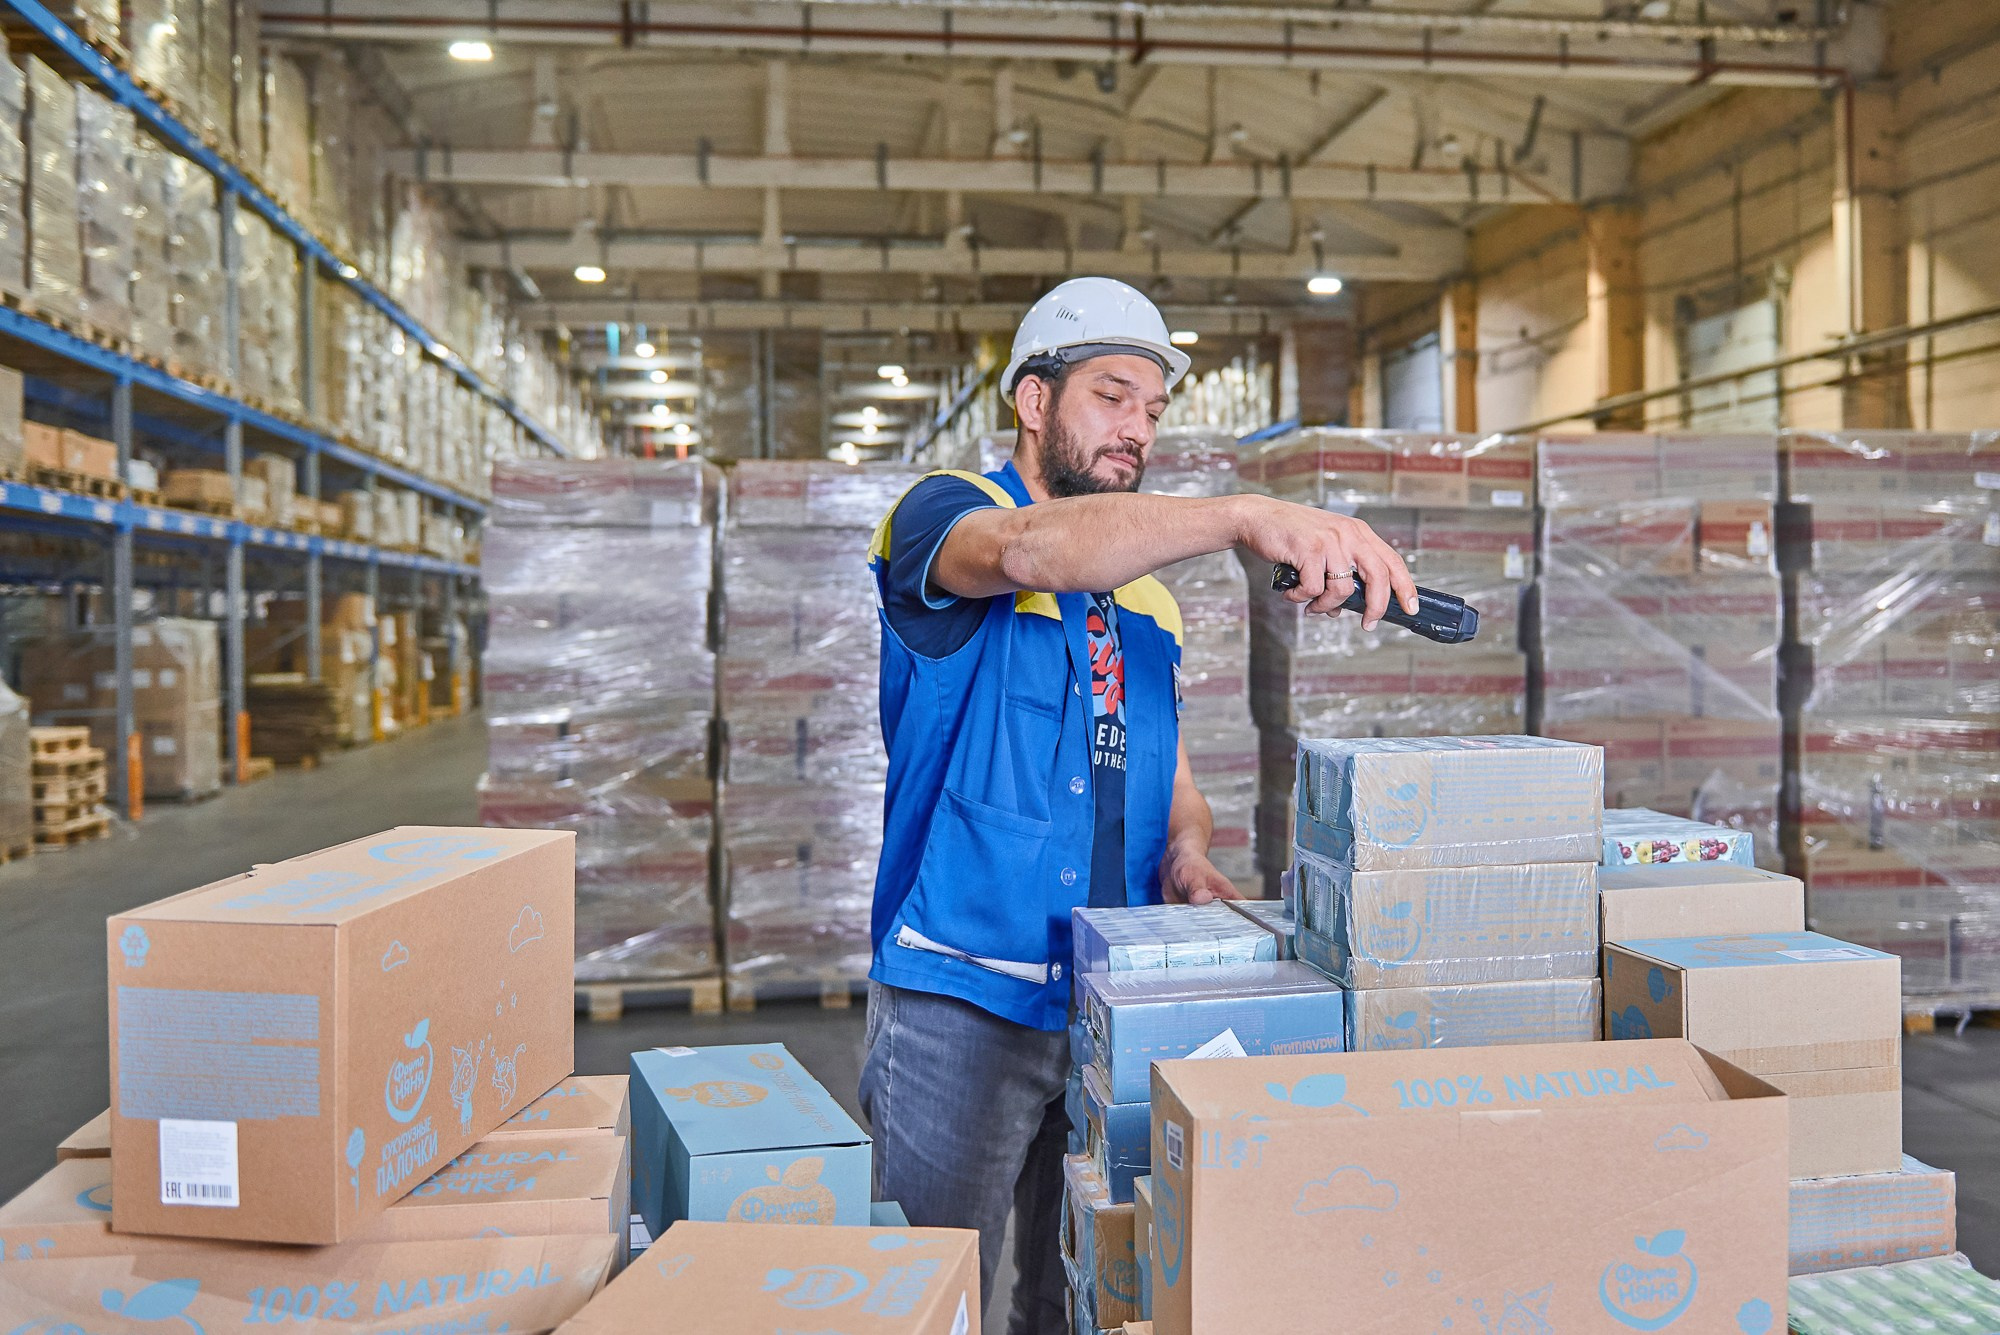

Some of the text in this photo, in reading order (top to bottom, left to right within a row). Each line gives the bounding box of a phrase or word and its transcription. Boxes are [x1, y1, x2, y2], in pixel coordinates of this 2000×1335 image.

[1391, 1064, 1677, 1110] 100% NATURAL
[376, 1127, 439, 1197] ПАЛОЧКИ
[382, 1115, 433, 1163] КУКУРУЗНЫЕ
[740, 1196, 819, 1223] Фруто
[242, 1262, 565, 1325] 100% NATURAL
